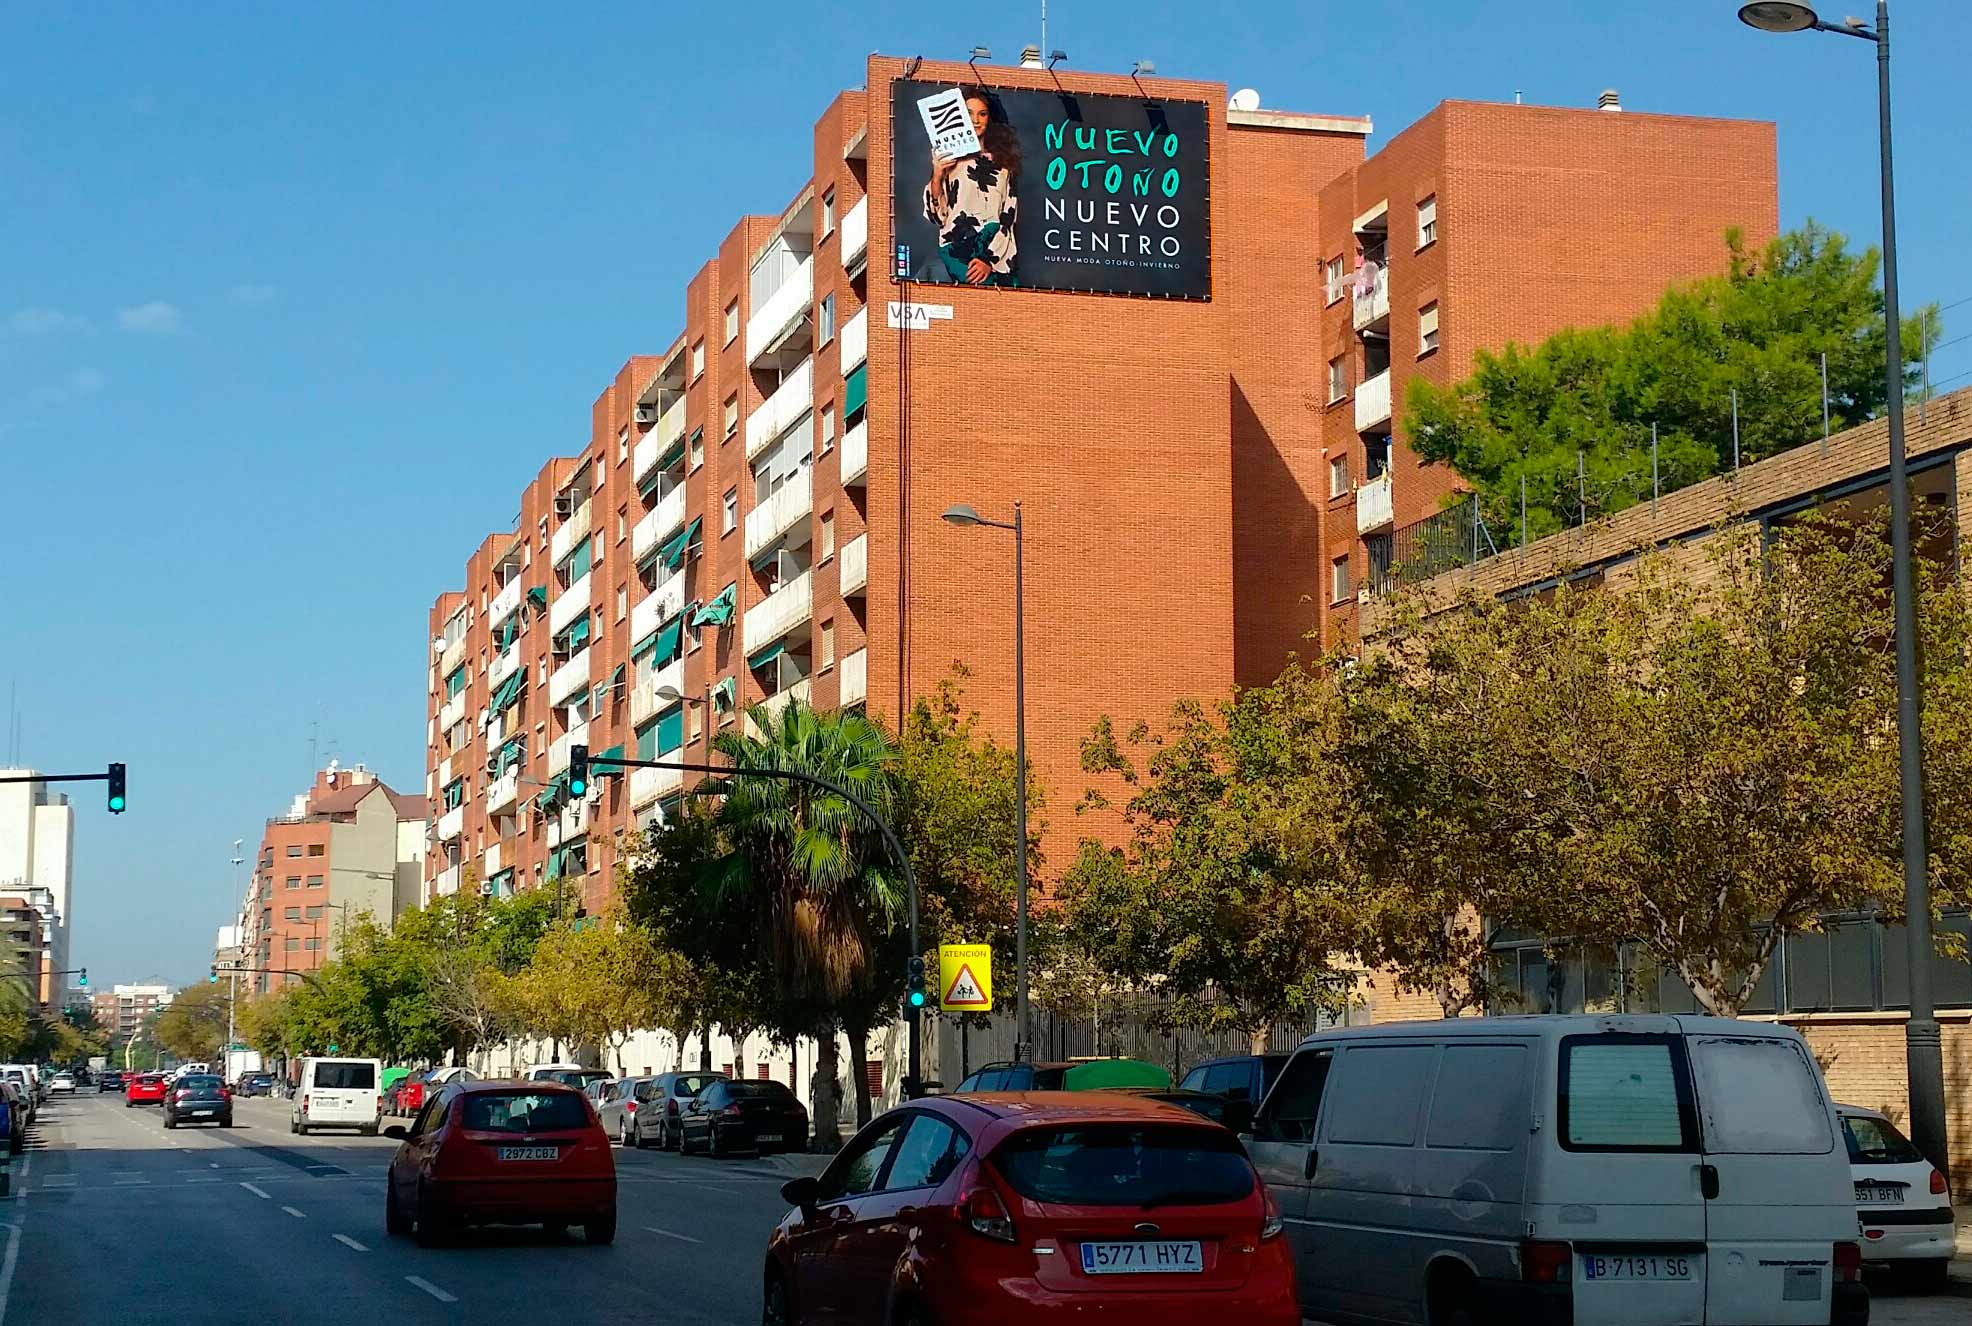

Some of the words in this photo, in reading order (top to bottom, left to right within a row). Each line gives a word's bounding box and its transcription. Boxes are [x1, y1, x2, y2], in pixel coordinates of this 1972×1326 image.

[1045, 119, 1178, 158] NUEVO
[1046, 157, 1180, 198] OTOÑO
[1045, 197, 1180, 229] NUEVO
[1044, 229, 1180, 257] CENTRO
[1044, 255, 1072, 263] NUEVA
[1076, 257, 1101, 265] MODA
[1096, 1245, 1147, 1265] 5771
[1156, 1244, 1196, 1264] HYZ
[1665, 1257, 1689, 1276] SG
